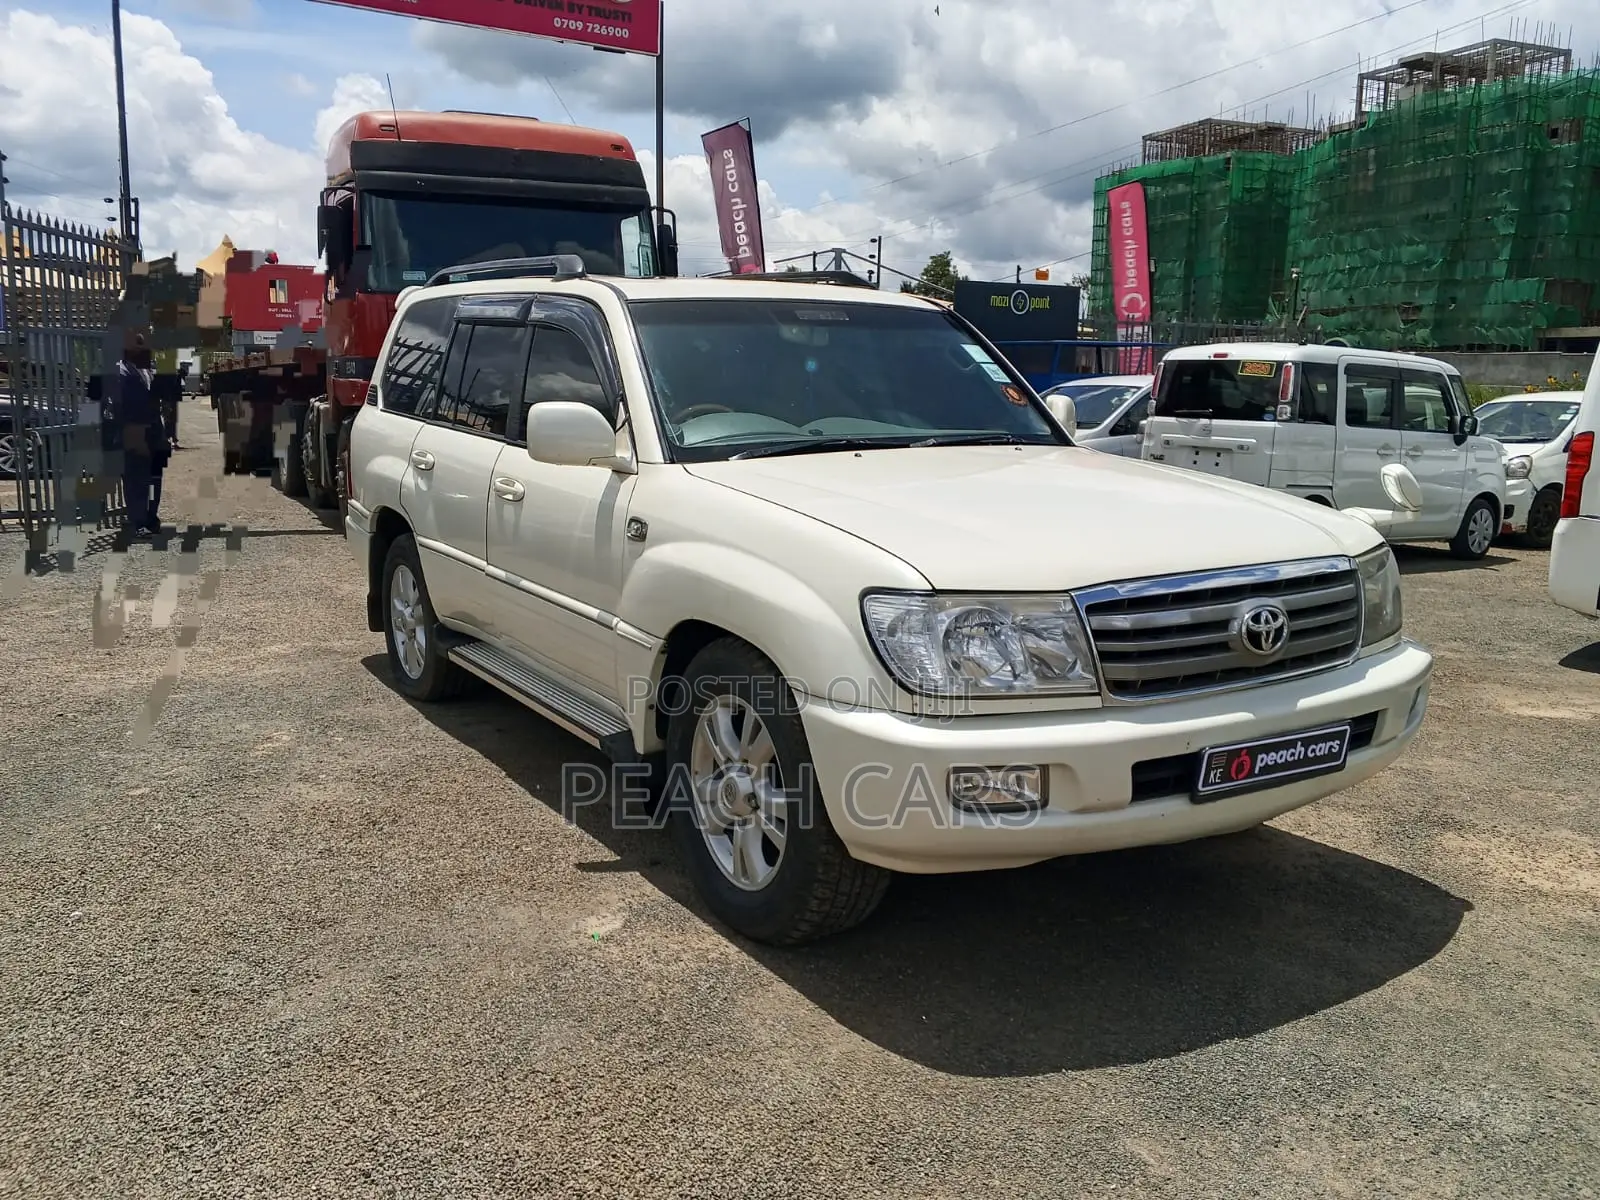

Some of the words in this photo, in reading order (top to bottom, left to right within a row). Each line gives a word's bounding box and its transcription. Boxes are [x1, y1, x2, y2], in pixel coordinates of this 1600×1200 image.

[567, 2, 584, 14] BY
[586, 5, 633, 23] TRUST!
[553, 17, 583, 31] 0709
[586, 22, 629, 38] 726900
[1030, 296, 1050, 311] point
[1254, 741, 1304, 774] peach
[1307, 739, 1341, 758] cars
[1208, 768, 1223, 783] KE
